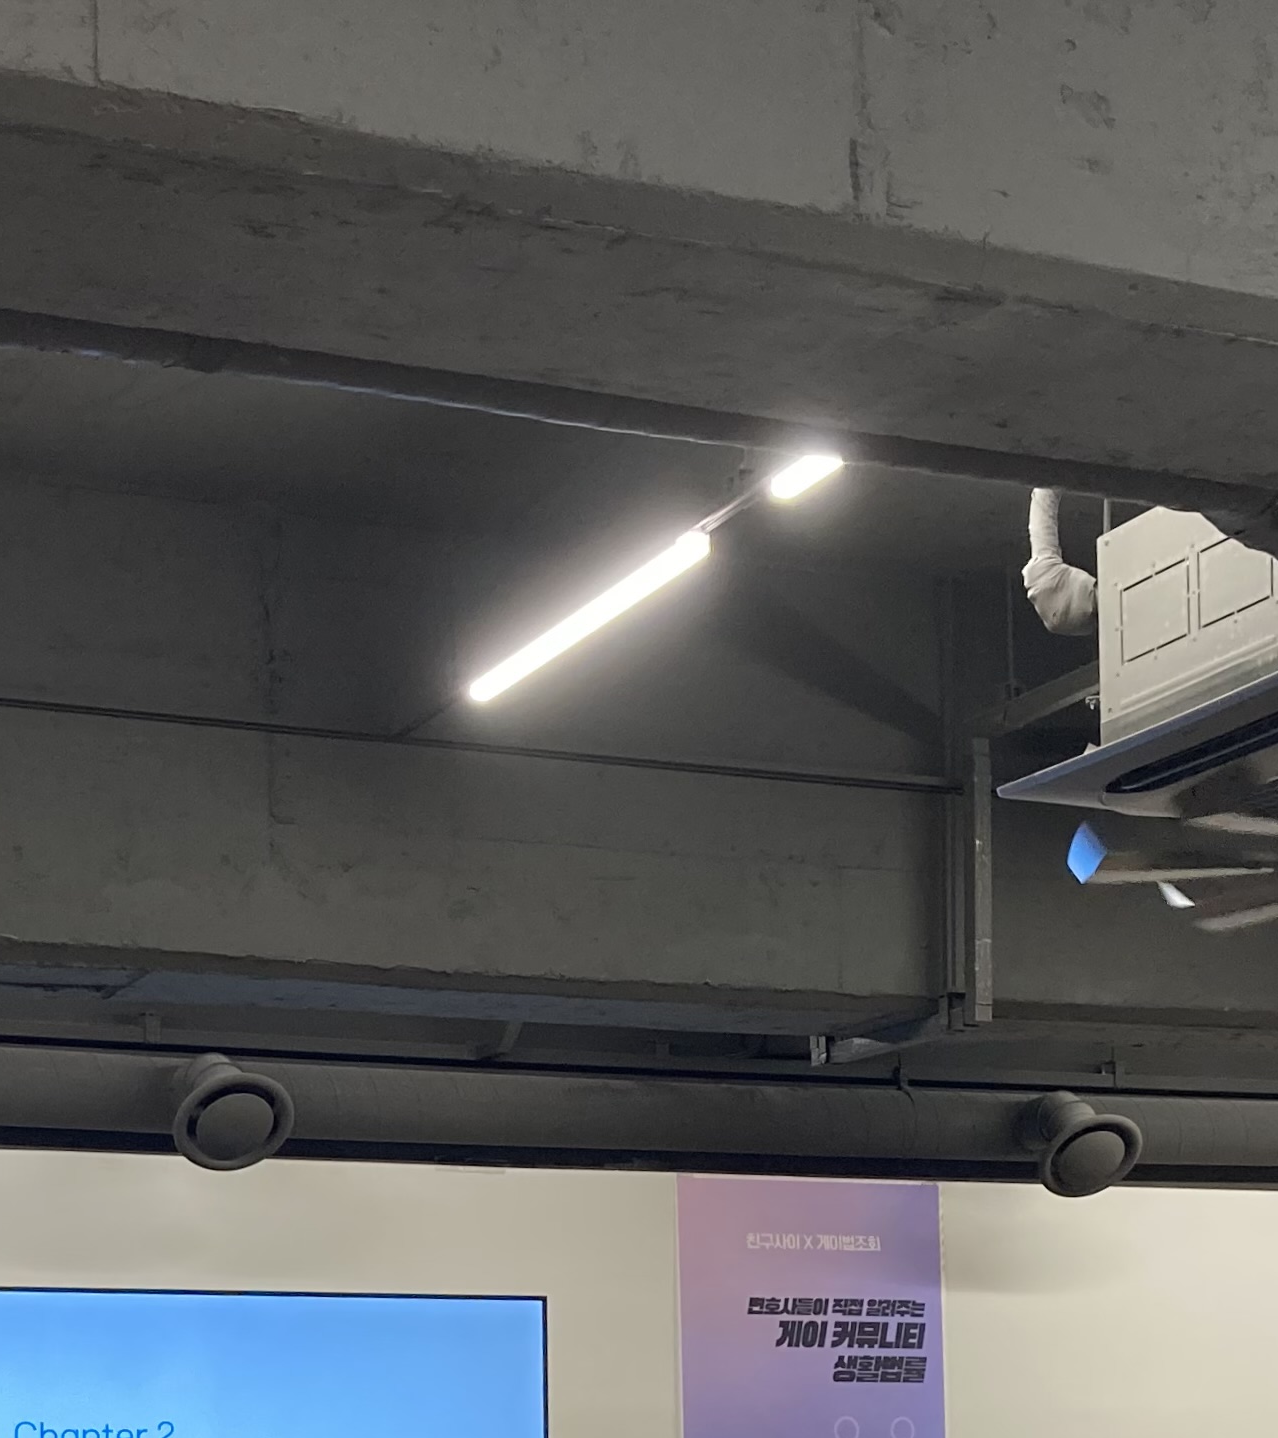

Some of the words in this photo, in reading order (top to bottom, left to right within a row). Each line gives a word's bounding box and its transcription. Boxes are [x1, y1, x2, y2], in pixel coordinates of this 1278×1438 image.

[746, 1233, 800, 1250] 친구사이
[816, 1235, 881, 1251] 게이법조회
[747, 1297, 829, 1316] 변호사들이
[832, 1298, 865, 1316] 직접
[866, 1298, 926, 1317] 알려주는
[775, 1320, 828, 1348] 게이
[830, 1321, 926, 1349] 커뮤니티
[832, 1355, 927, 1383] 생활법률
